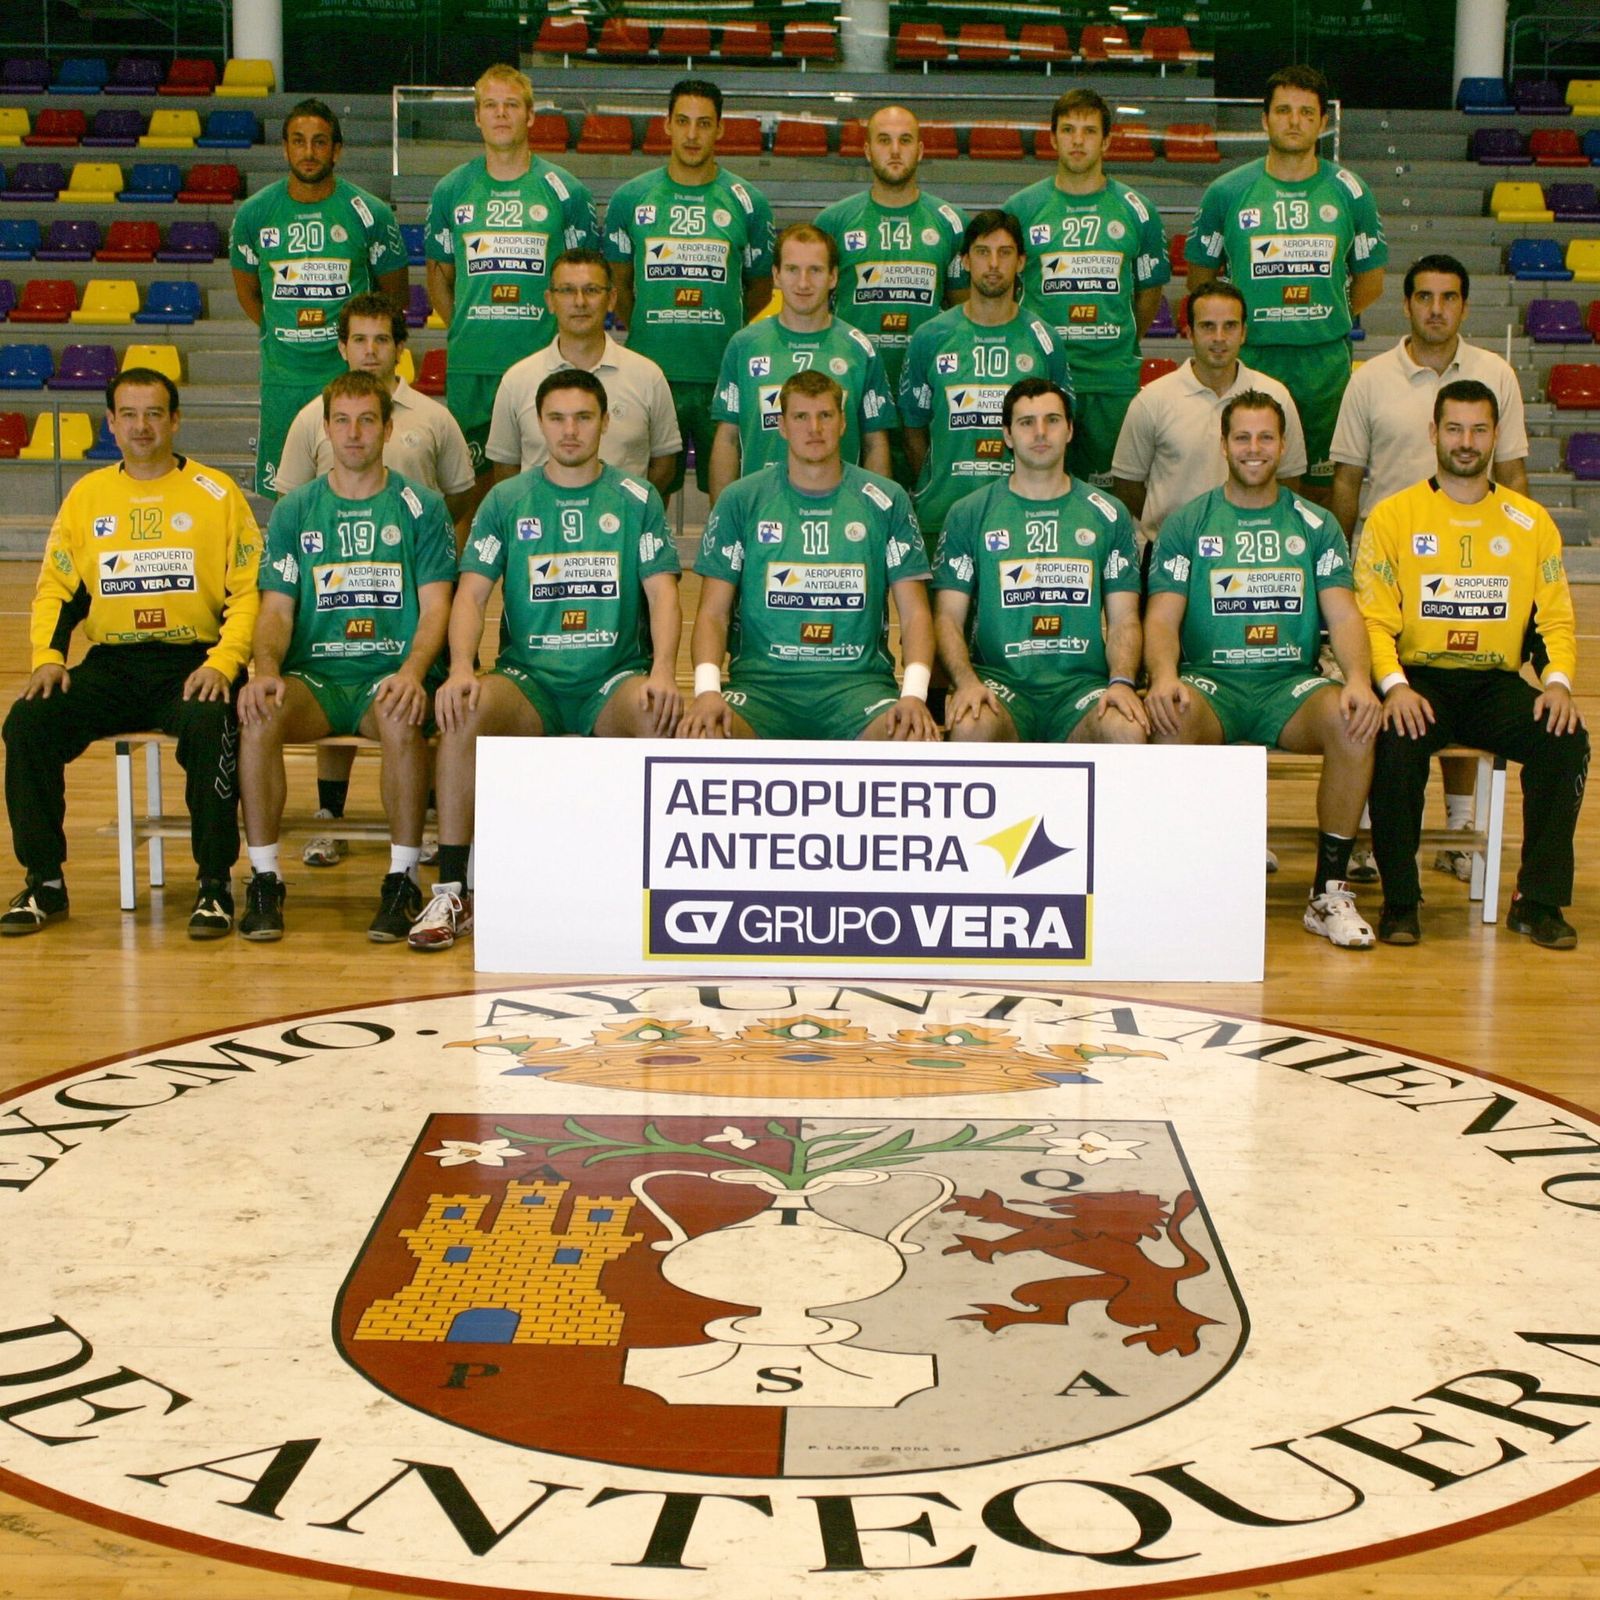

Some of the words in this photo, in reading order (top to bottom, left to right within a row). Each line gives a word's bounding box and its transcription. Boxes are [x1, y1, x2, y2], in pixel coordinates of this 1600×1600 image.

[486, 200, 523, 227] 22
[1274, 201, 1308, 229] 13
[670, 206, 705, 235] 25
[288, 222, 324, 253] 20
[879, 222, 911, 249] 14
[1063, 216, 1100, 247] 27
[470, 260, 493, 271] GRUPO
[498, 260, 527, 269] VERA
[649, 266, 676, 276] GRUPO
[681, 267, 708, 276] VERA
[1255, 264, 1284, 274] GRUPO
[1287, 264, 1315, 273] VERA
[303, 288, 332, 296] VERA
[494, 286, 518, 297] ATE
[1045, 282, 1071, 291] GRUPO
[1077, 281, 1102, 290] VERA
[677, 290, 700, 301] ATE
[889, 290, 915, 299] VERA
[1285, 288, 1307, 298] ATE
[299, 310, 323, 321] ATE
[1071, 307, 1095, 318] ATE
[883, 315, 907, 326] ATE
[275, 322, 339, 337] negoci
[1055, 323, 1120, 338] egocity
[793, 352, 813, 372] 7
[973, 346, 1008, 377] 10
[978, 390, 1007, 398] AEROP
[977, 400, 1003, 409] ANTEQ
[765, 416, 779, 426] GRU
[981, 415, 1002, 424] VER
[978, 441, 1002, 452] ATE
[952, 460, 1014, 471] negoci
[130, 508, 162, 540] 12
[562, 509, 583, 543] 9
[338, 521, 375, 557] 19
[801, 521, 829, 555] 11
[1026, 521, 1058, 553] 21
[1235, 530, 1280, 563] 28
[1460, 535, 1472, 568] 1
[134, 551, 192, 561] AEROPUERTO
[134, 564, 187, 573] ANTEQUERA
[805, 569, 863, 578] AEROPUERTO
[1248, 573, 1301, 582] AEROPUERTO
[1454, 578, 1508, 587] AEROPUERTO
[103, 581, 135, 592] GRUPO
[141, 578, 171, 589] VERA
[568, 585, 597, 594] VERA
[805, 581, 858, 590] ANTEQUERA
[1248, 585, 1296, 593] ANTEQUERA
[770, 594, 804, 605] GRUPO
[810, 597, 841, 606] VERA
[1454, 590, 1503, 599] ANTEQUERA
[1216, 600, 1246, 610] GRUPO
[1253, 600, 1280, 609] VERA
[1424, 604, 1453, 615] GRUPO
[1459, 606, 1489, 616] VERA
[137, 611, 162, 623] ATE
[563, 612, 584, 625] ATE
[348, 620, 372, 632] ATE
[1035, 618, 1059, 630] ATE
[804, 625, 831, 638] ATE
[1248, 626, 1275, 639] ATE
[1450, 633, 1476, 645] ATE
[665, 779, 996, 820] AEROPUERTO
[665, 832, 969, 874] ANTEQUERA
[738, 905, 902, 946] GRUPO
[911, 905, 1074, 949] VERA
[1021, 1167, 1086, 1192] Q
[437, 1362, 501, 1390] P
[755, 1365, 804, 1393] S
[1053, 1370, 1130, 1397] A
